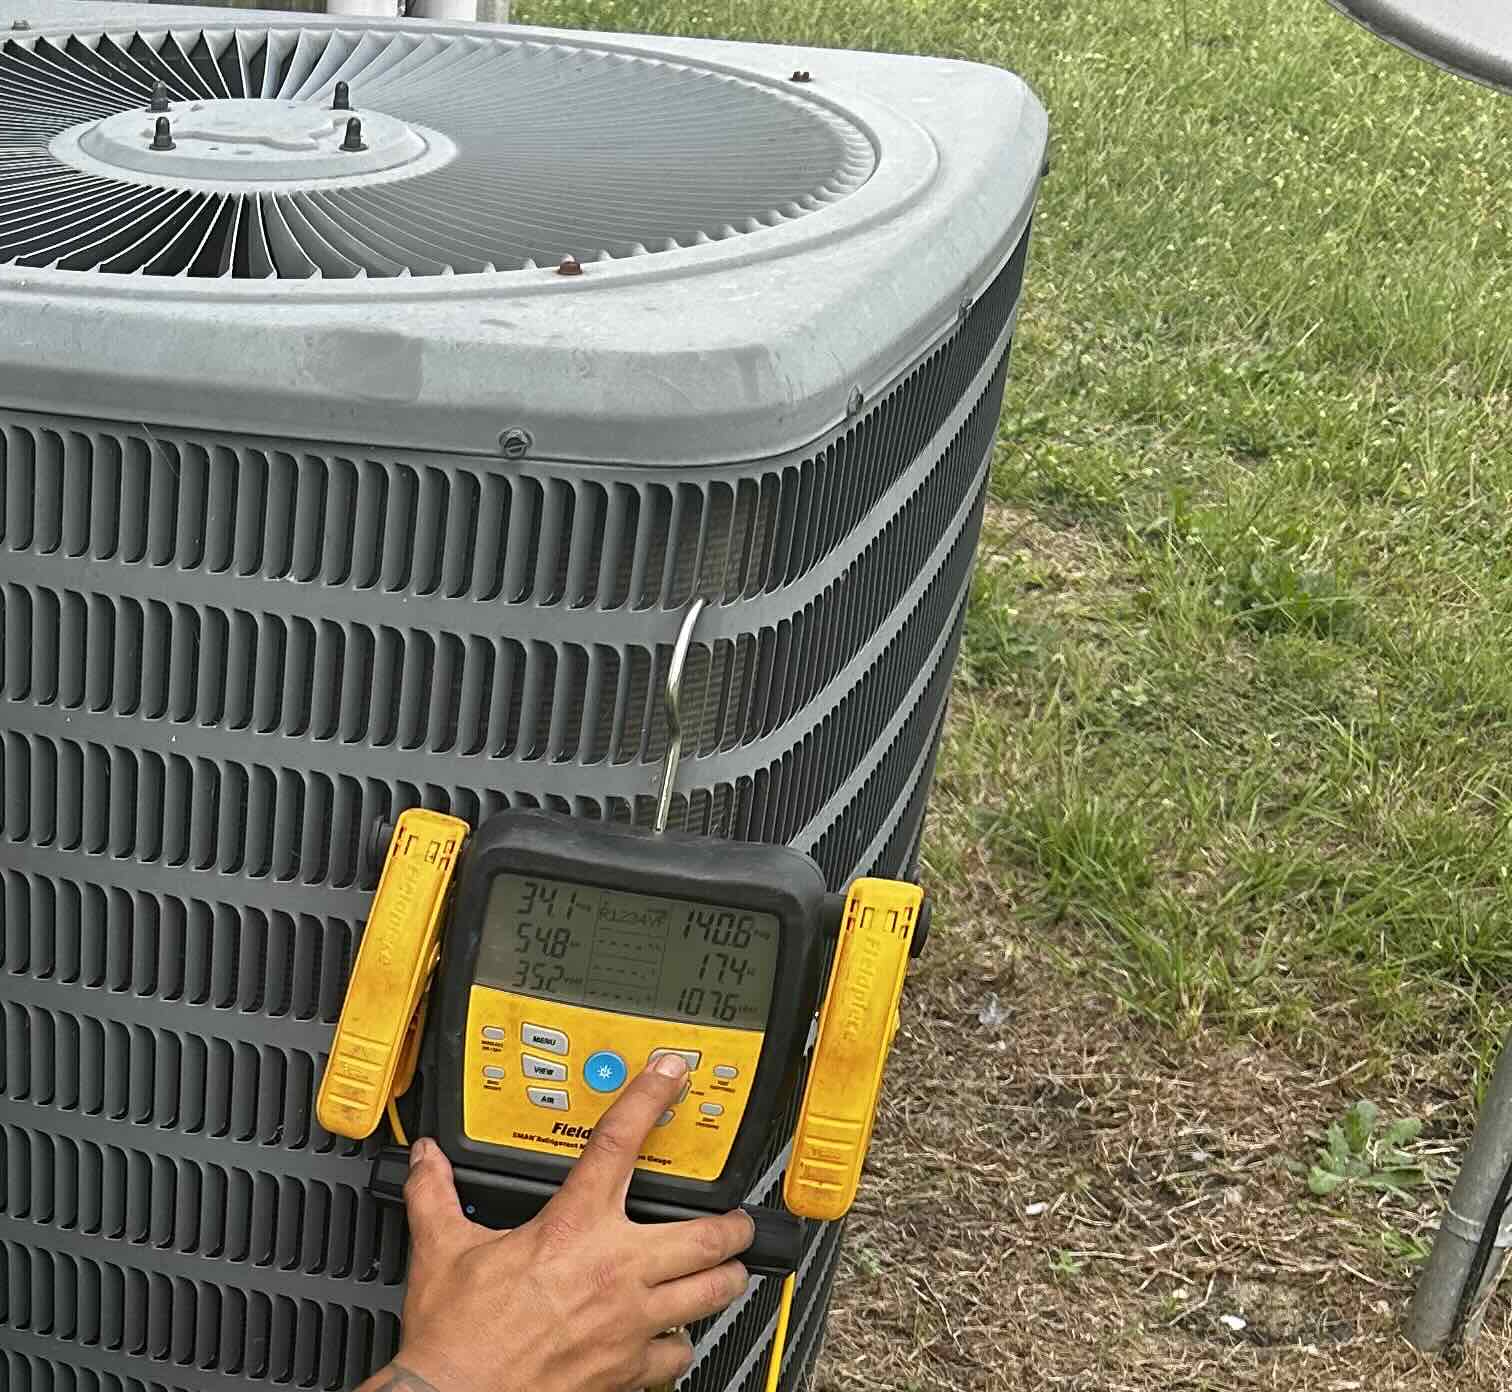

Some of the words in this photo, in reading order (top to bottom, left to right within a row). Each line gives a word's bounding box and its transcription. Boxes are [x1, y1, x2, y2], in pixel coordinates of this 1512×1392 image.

[533, 1035, 557, 1046] MENU
[534, 1065, 554, 1076] VIEW
[541, 1095, 555, 1104] AIR
[552, 1122, 593, 1140] Field
